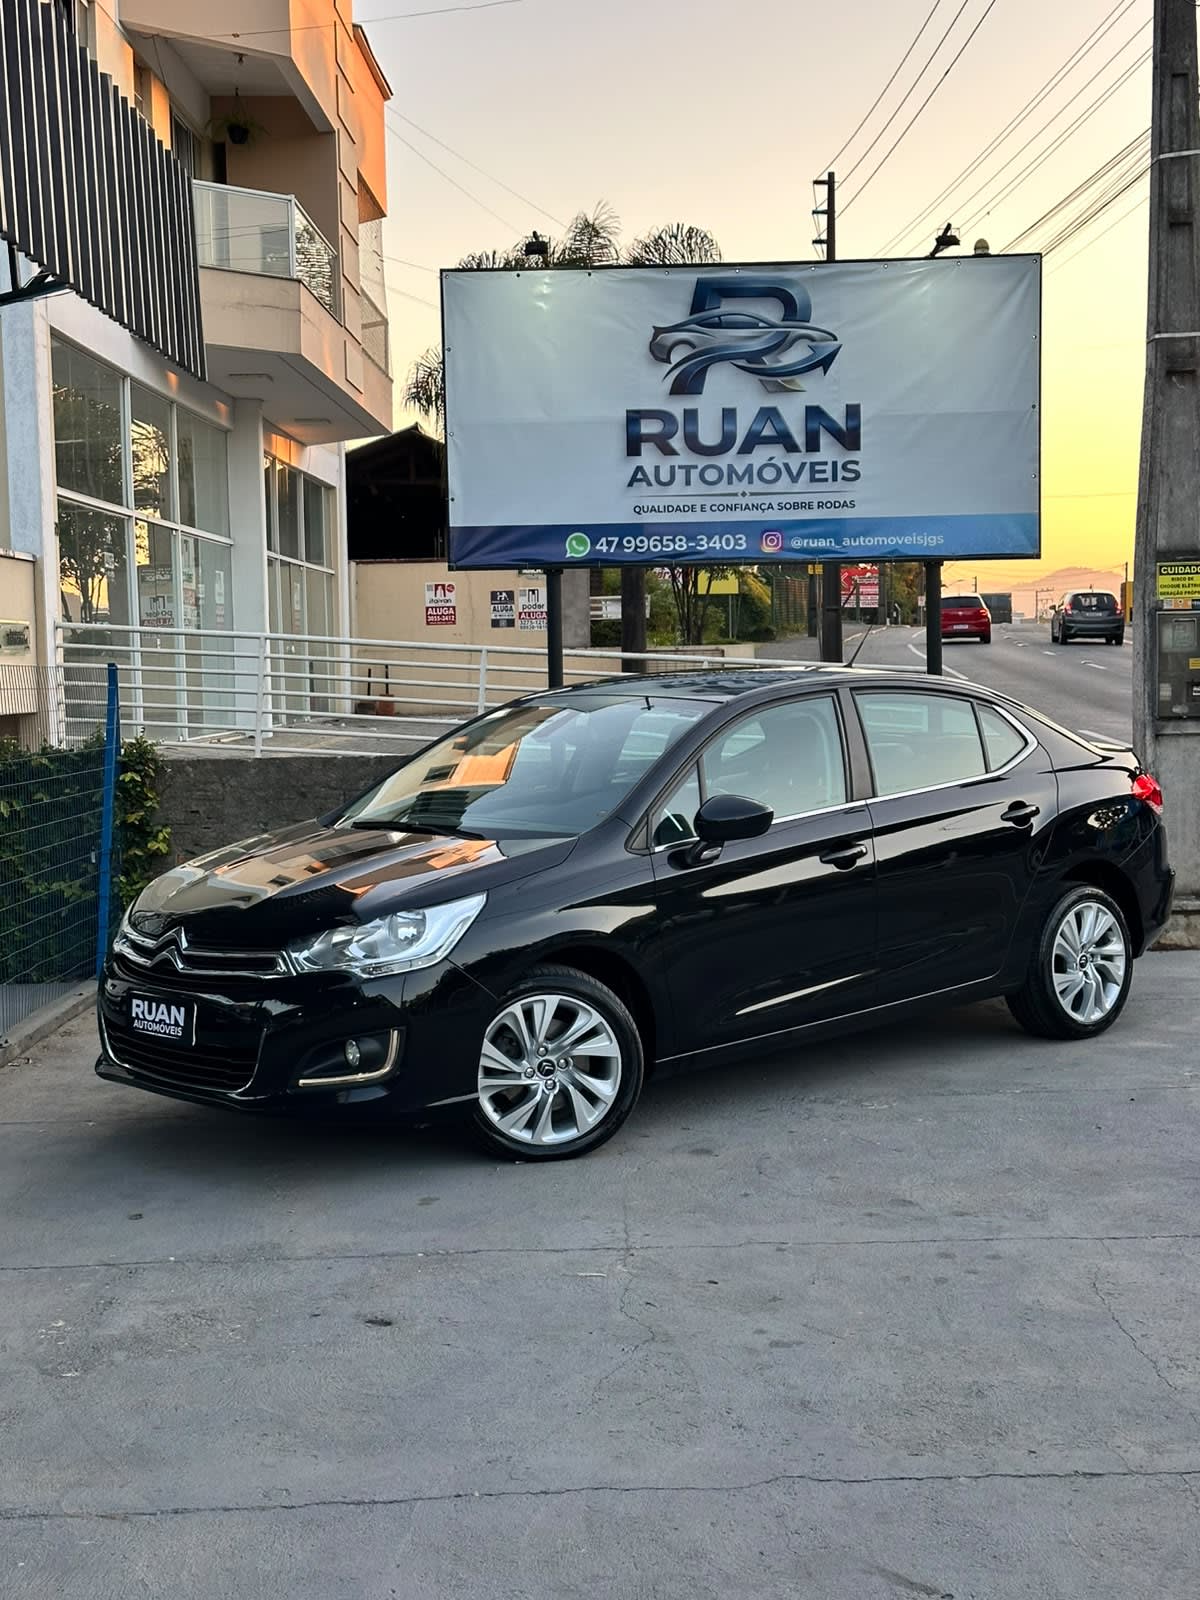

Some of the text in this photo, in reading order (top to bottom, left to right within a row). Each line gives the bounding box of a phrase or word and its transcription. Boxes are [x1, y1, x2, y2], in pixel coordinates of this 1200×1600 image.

[626, 404, 861, 456] RUAN
[627, 457, 861, 487] AUTOMÓVEIS
[633, 500, 856, 515] QUALIDADE E CONFIANÇA SOBRE RODAS
[595, 534, 747, 552] 47 99658-3403
[791, 533, 944, 549] @ruan_automoveisjgs
[132, 999, 185, 1026] RUAN
[133, 1019, 182, 1036] AUTOMÓVEIS
